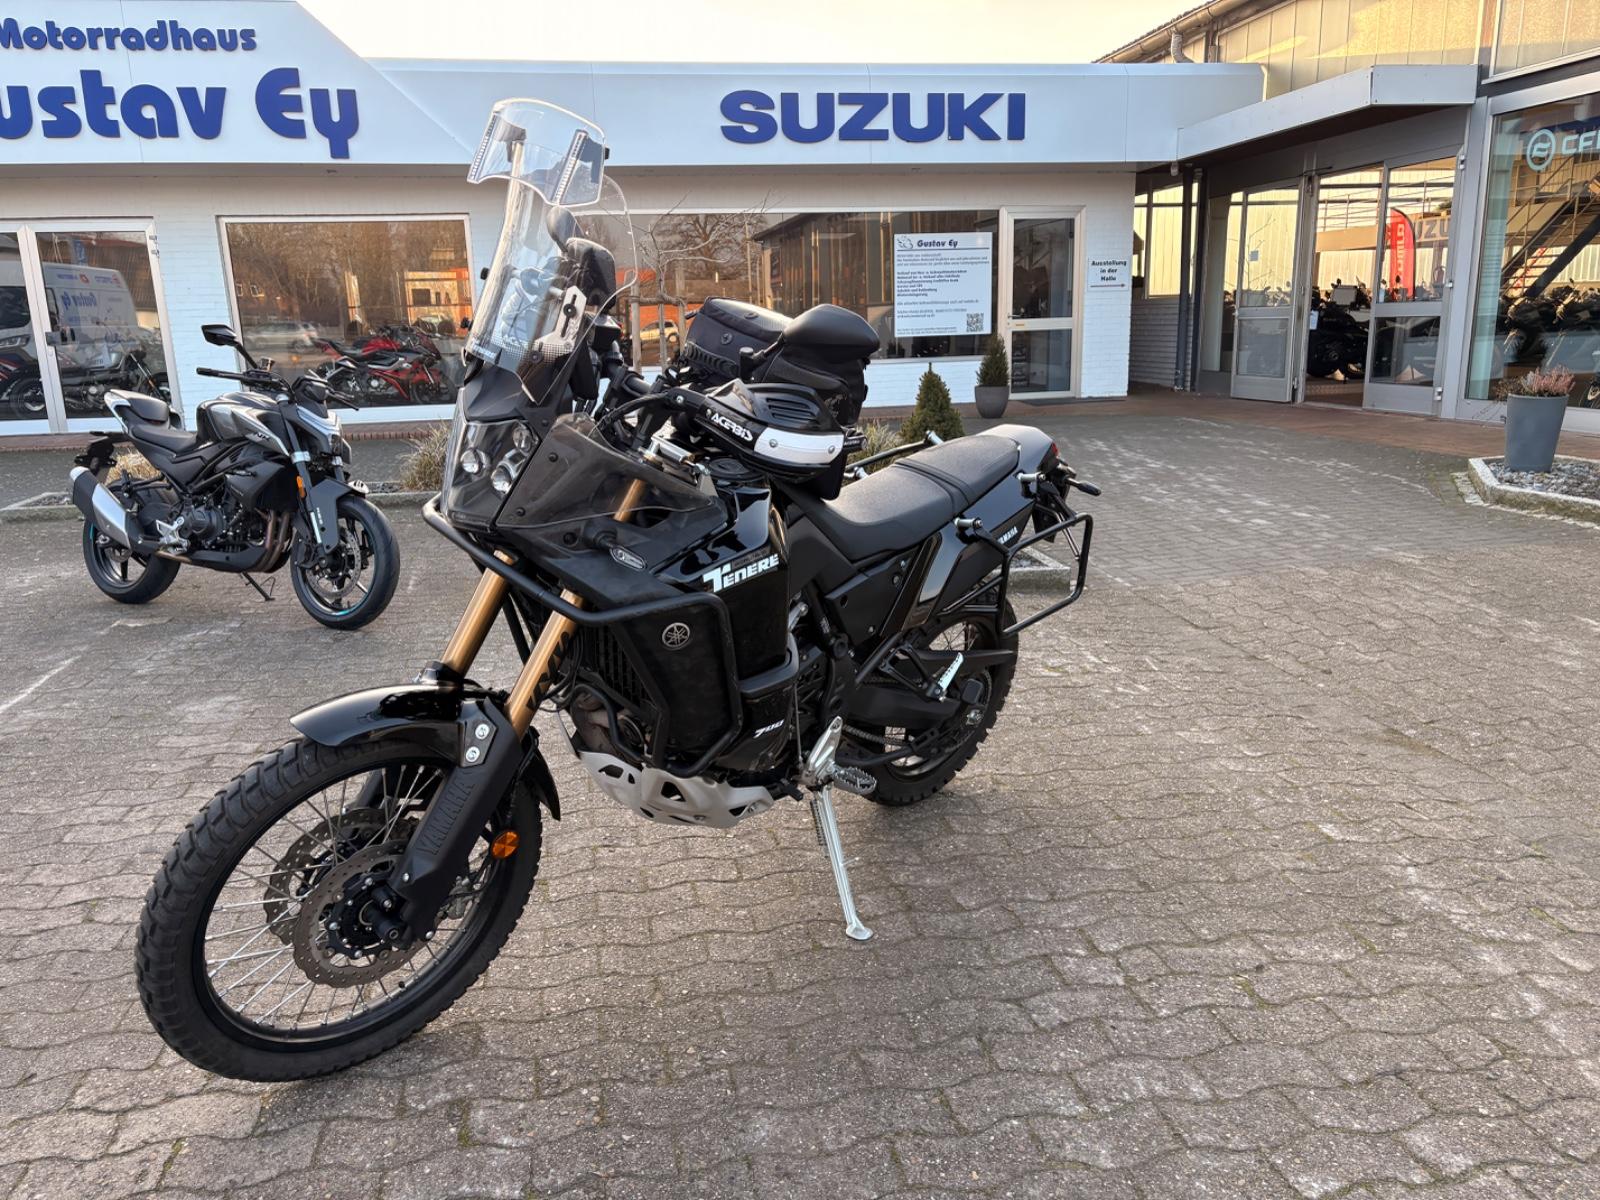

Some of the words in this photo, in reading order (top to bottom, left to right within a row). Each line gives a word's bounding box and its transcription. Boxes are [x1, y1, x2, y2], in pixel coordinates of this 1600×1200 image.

[0, 18, 257, 51] Motorradhaus
[0, 69, 227, 140] ustav
[255, 67, 359, 159] Ey
[720, 89, 1026, 144] SUZUKI
[1561, 129, 1600, 155] CF
[1415, 217, 1448, 239] UZU
[917, 240, 946, 248] Gustav
[948, 239, 958, 248] Ey
[711, 412, 754, 442] ACERBIS
[753, 719, 785, 739] 700
[416, 771, 475, 856] YAMAHA
